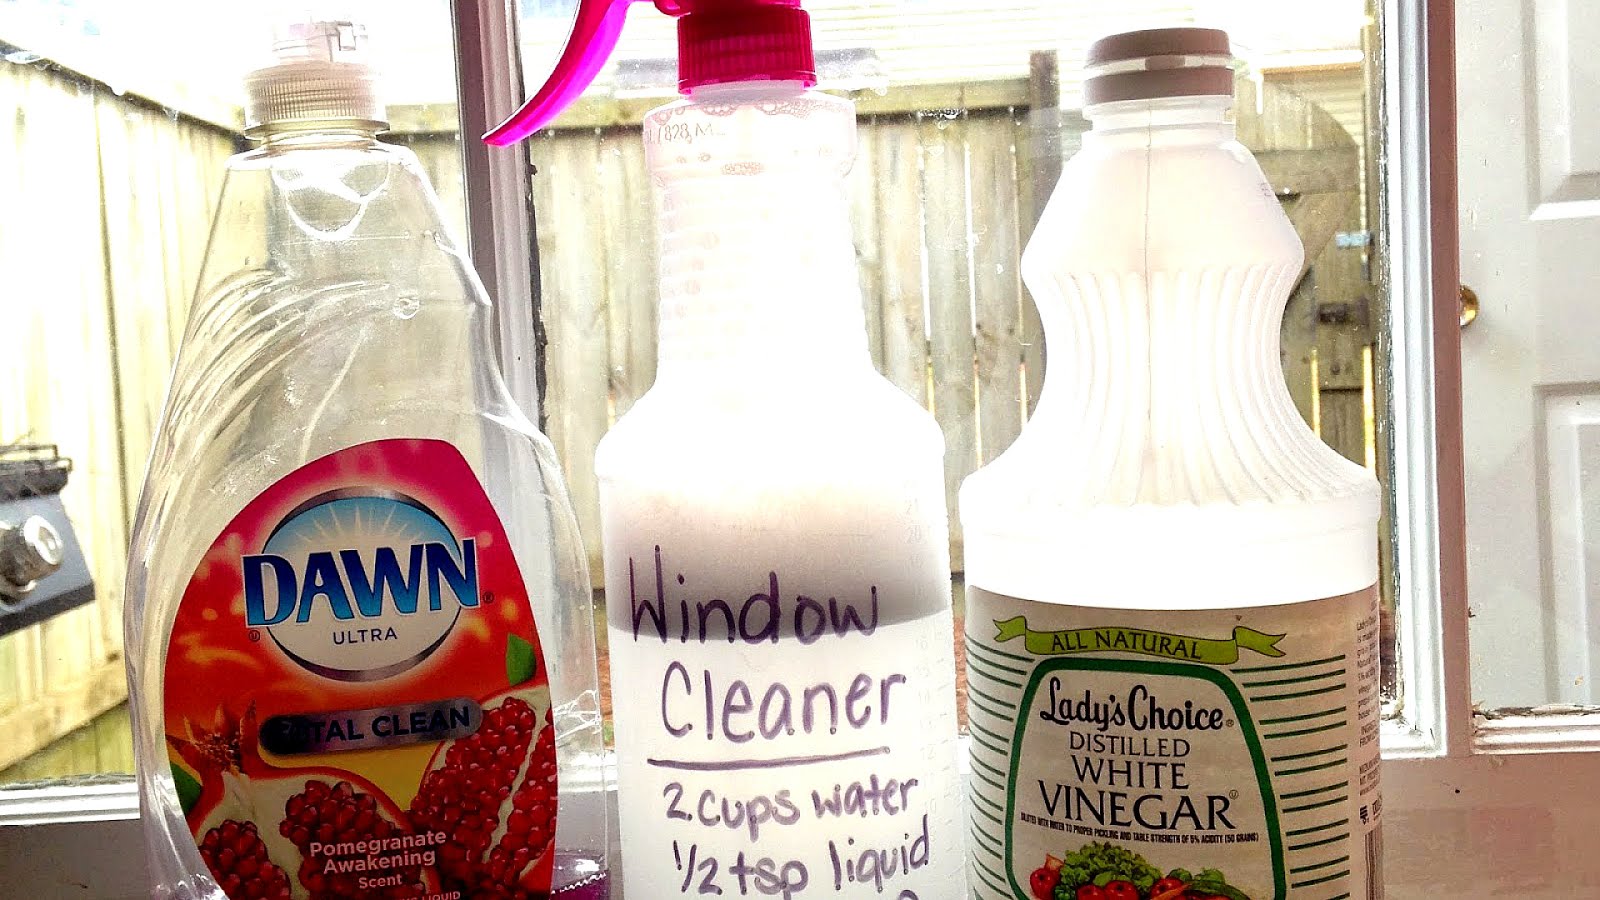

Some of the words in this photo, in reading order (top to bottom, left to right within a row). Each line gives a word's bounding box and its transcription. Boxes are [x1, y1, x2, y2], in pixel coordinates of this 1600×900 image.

[242, 538, 480, 627] DAWN
[629, 545, 878, 643] Window
[333, 627, 397, 645] ULTRA
[1051, 632, 1088, 651] ALL
[1095, 630, 1203, 659] NATURAL
[662, 661, 907, 742] Cleaner
[1128, 684, 1223, 732] Choice
[372, 706, 470, 737] CLEAN
[1070, 730, 1191, 758] DISTILLED
[1071, 754, 1190, 789] WHITE
[663, 782, 693, 821] 2
[812, 774, 919, 818] water
[1038, 779, 1237, 830] VINEGAR
[310, 831, 446, 857] Pomegranate
[1065, 823, 1073, 833] TO
[1073, 825, 1093, 836] PROPER
[1094, 828, 1119, 840] PICKLING
[1120, 831, 1132, 841] AND
[1133, 832, 1150, 842] TABLE
[1150, 833, 1181, 844] STRENGTH
[1181, 834, 1190, 844] OF
[1190, 834, 1200, 844] 5%
[1201, 834, 1224, 844] ACIDITY
[323, 850, 436, 875] Awakening
[673, 840, 722, 896] 1/2
[729, 851, 809, 900] tsp
[829, 814, 929, 893] liquid
[358, 874, 403, 890] Scent
